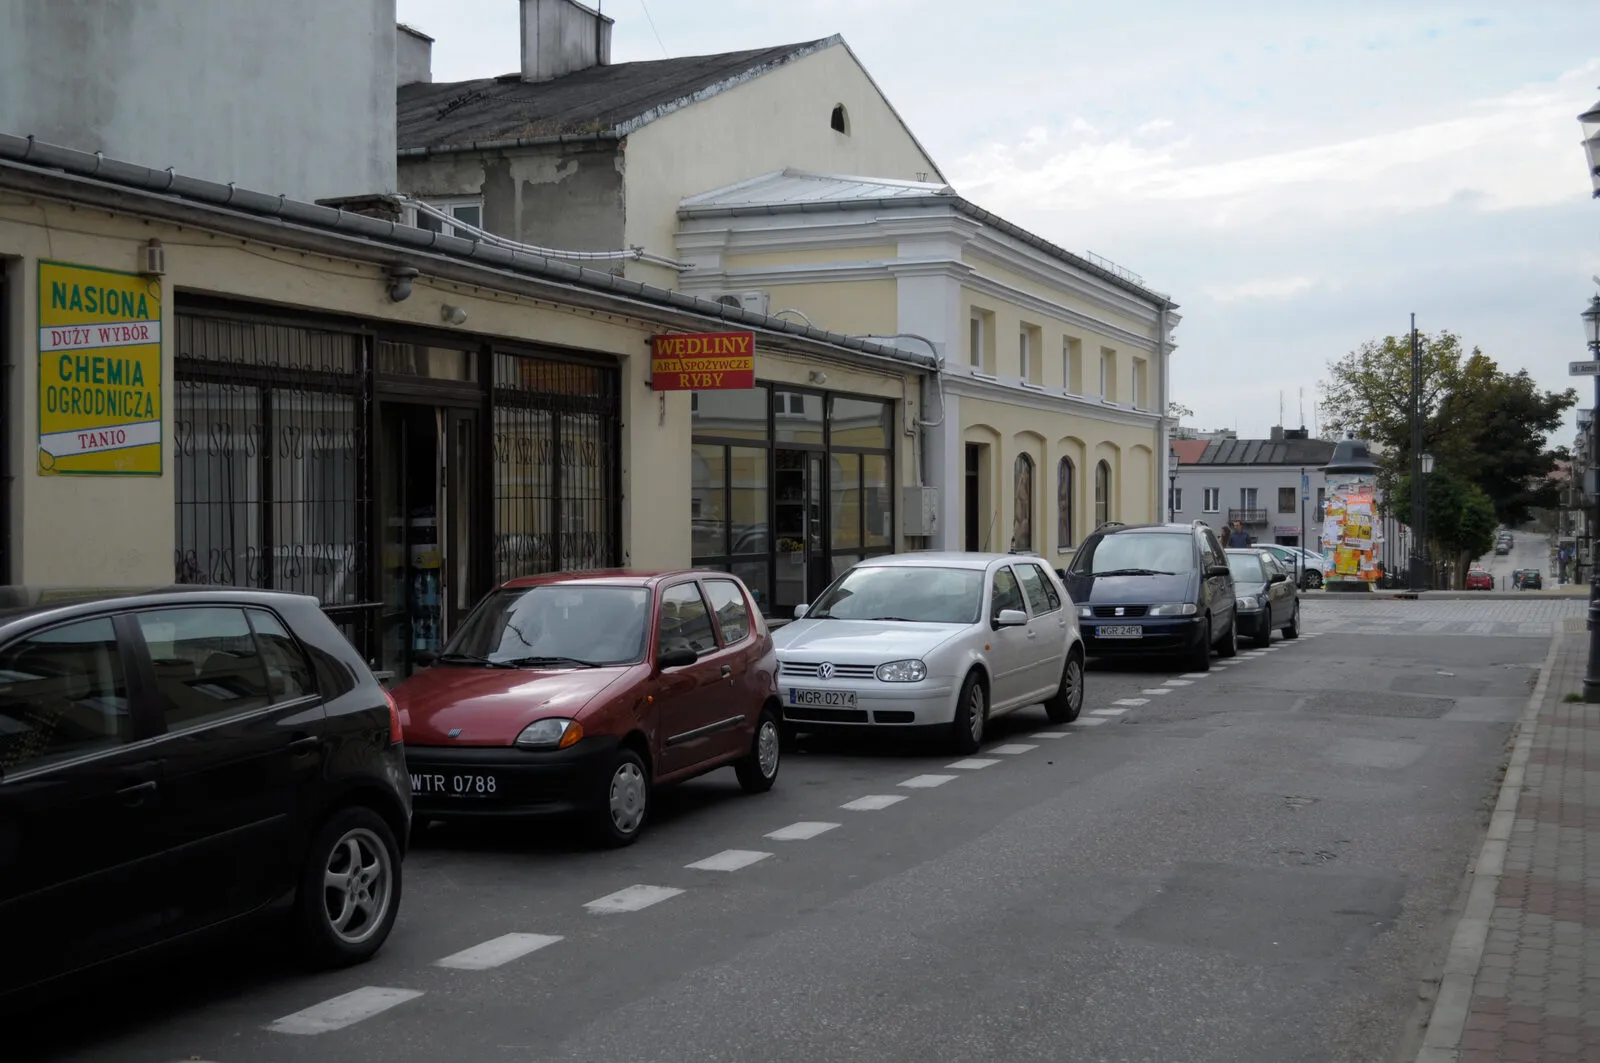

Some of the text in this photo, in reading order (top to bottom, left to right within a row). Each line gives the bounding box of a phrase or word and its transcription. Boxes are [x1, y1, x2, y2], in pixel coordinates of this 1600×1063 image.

[52, 280, 149, 320] NASIONA
[52, 324, 149, 347] DUŻY WYBÓR
[656, 336, 749, 358] WĘDLINY
[59, 354, 145, 387] CHEMIA
[683, 359, 750, 371] SPOŻYWCZE
[680, 372, 723, 387] RYBY
[46, 385, 154, 418] OGRODNICZA
[78, 429, 126, 450] TANIO
[1101, 626, 1118, 635] WGR
[797, 690, 822, 704] WGR
[410, 774, 496, 793] WTR 0788
